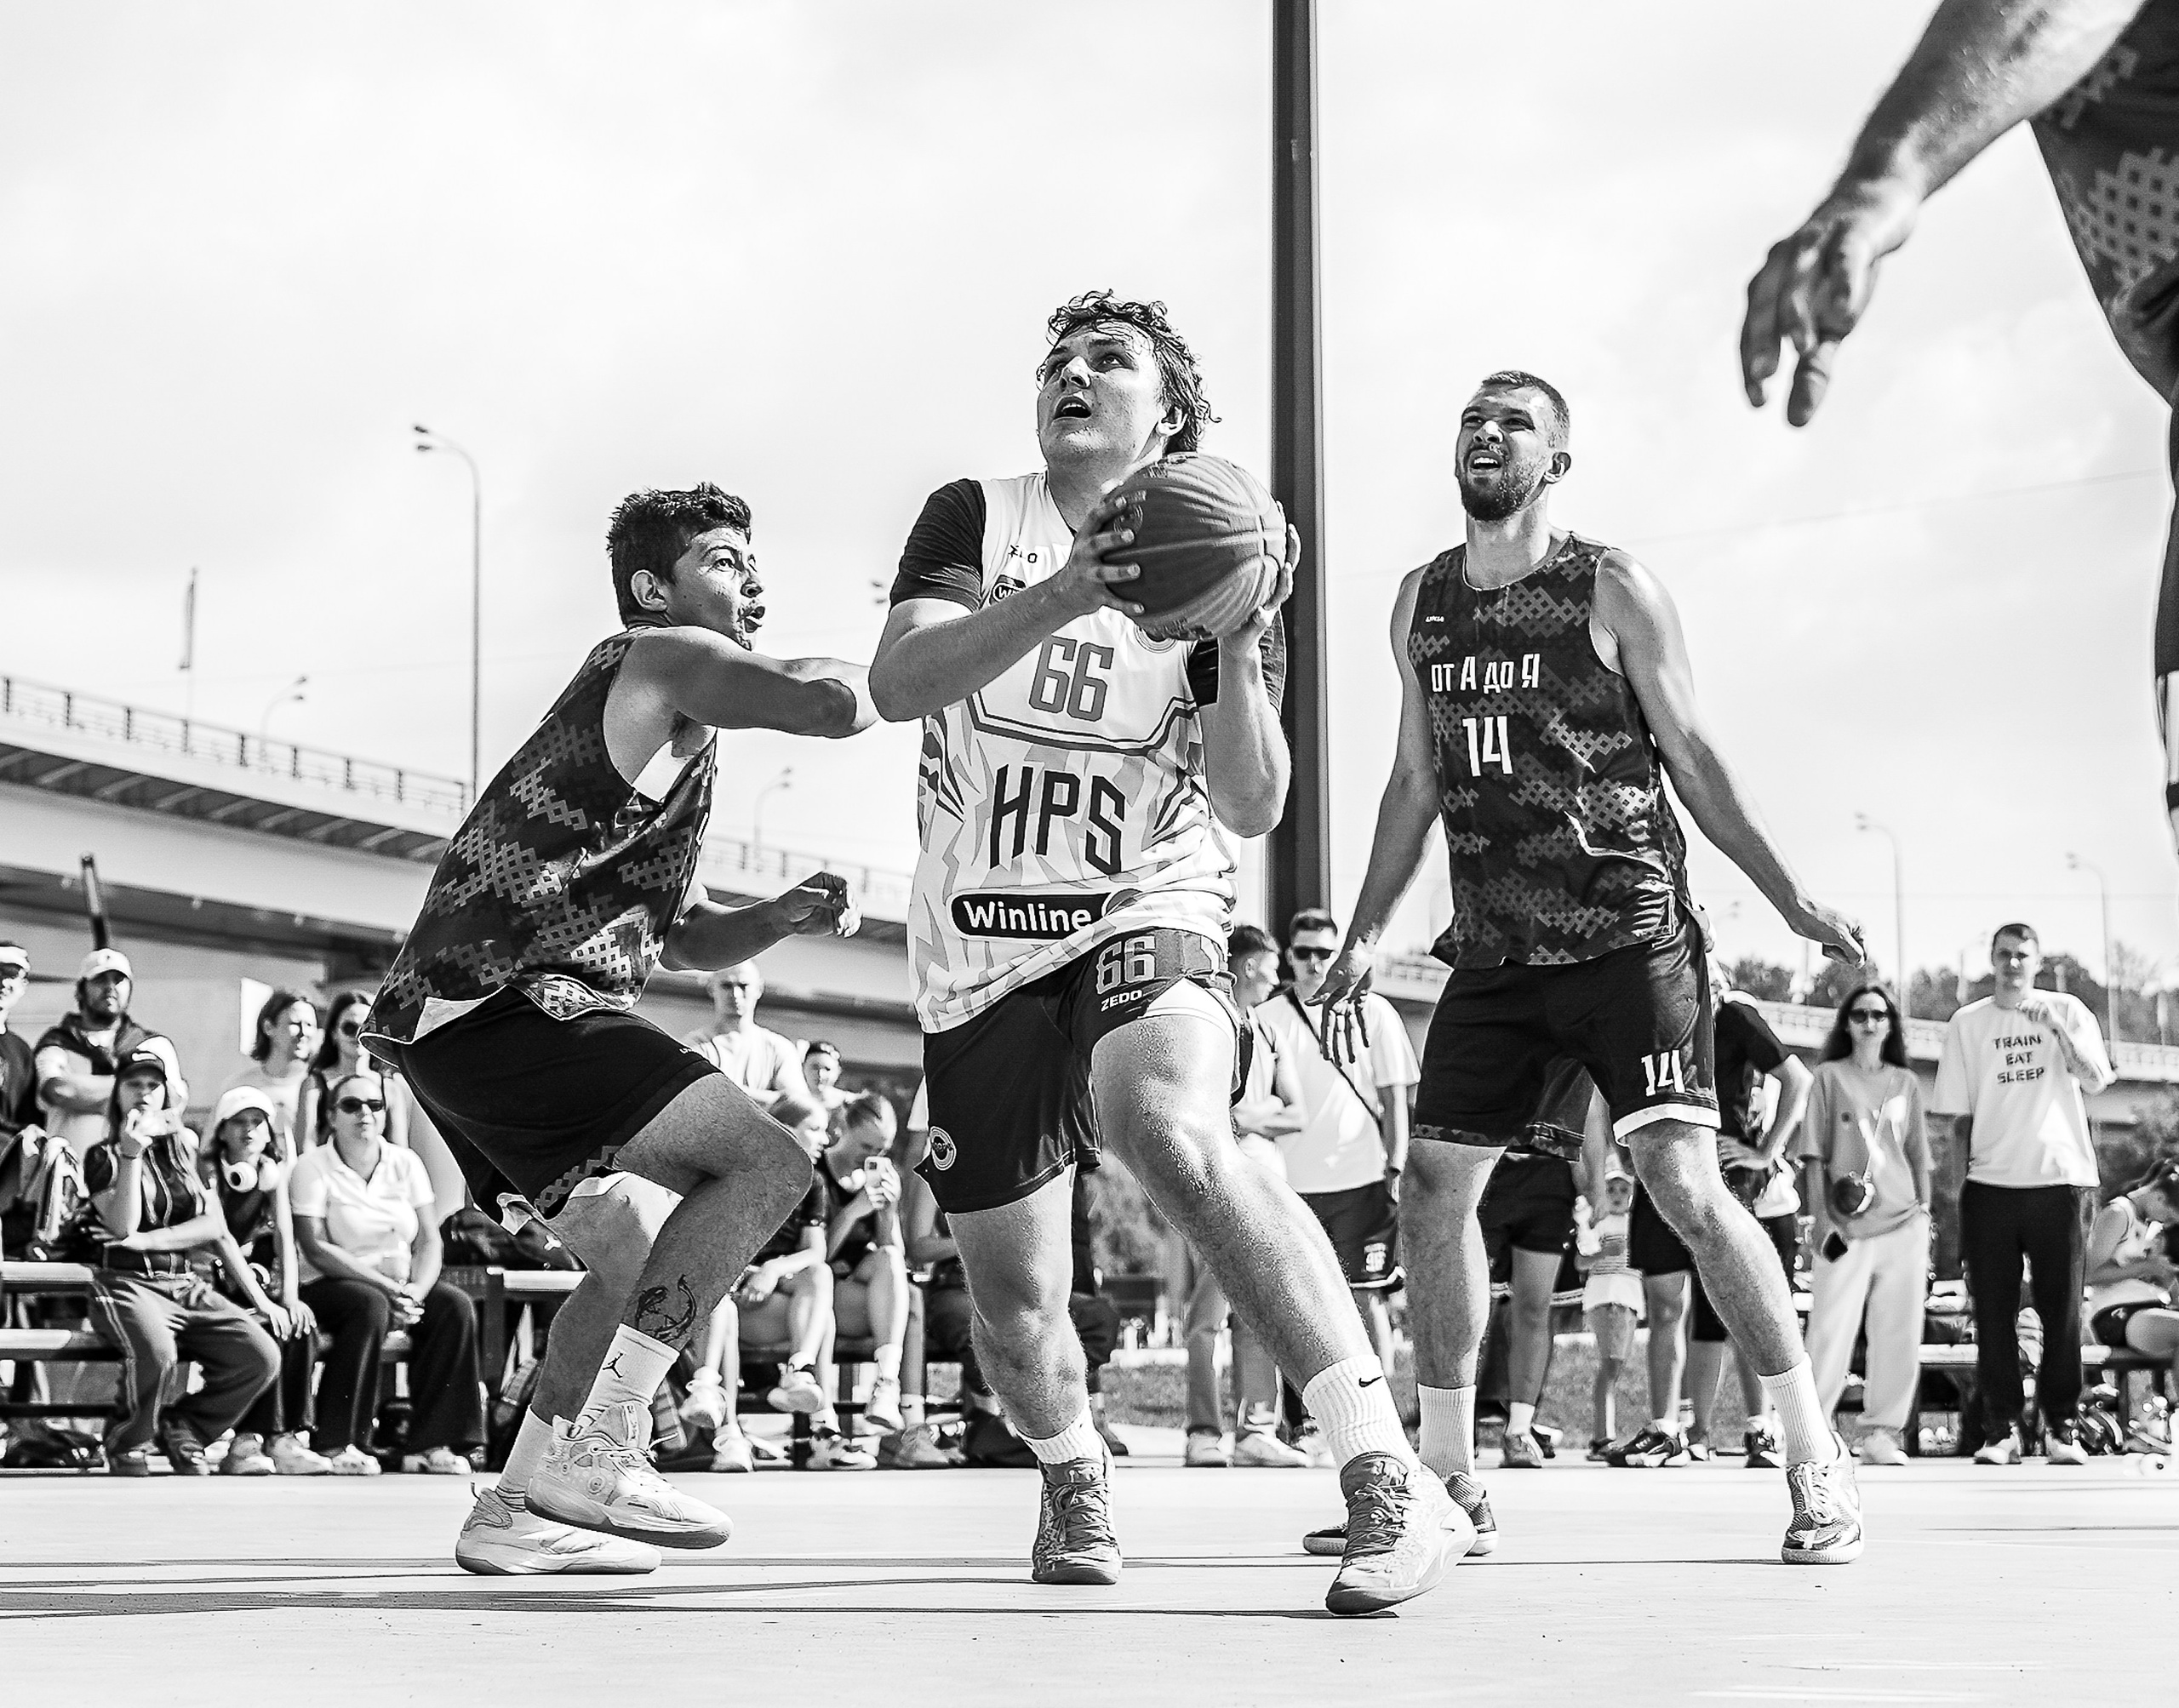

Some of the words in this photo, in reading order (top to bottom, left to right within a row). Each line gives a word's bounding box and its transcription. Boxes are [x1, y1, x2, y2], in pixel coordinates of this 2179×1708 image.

[1029, 635, 1114, 722] 66
[1521, 653, 1540, 688] Я
[1462, 716, 1513, 777] 14
[989, 763, 1125, 876] HPS
[963, 900, 1092, 932] Winline
[1095, 935, 1156, 995] 66
[1101, 989, 1142, 1012] ZEDO
[1993, 1035, 2041, 1049] TRAIN
[2005, 1051, 2033, 1065] EAT
[1640, 1049, 1685, 1097] 14
[1997, 1065, 2045, 1084] SLEEP
